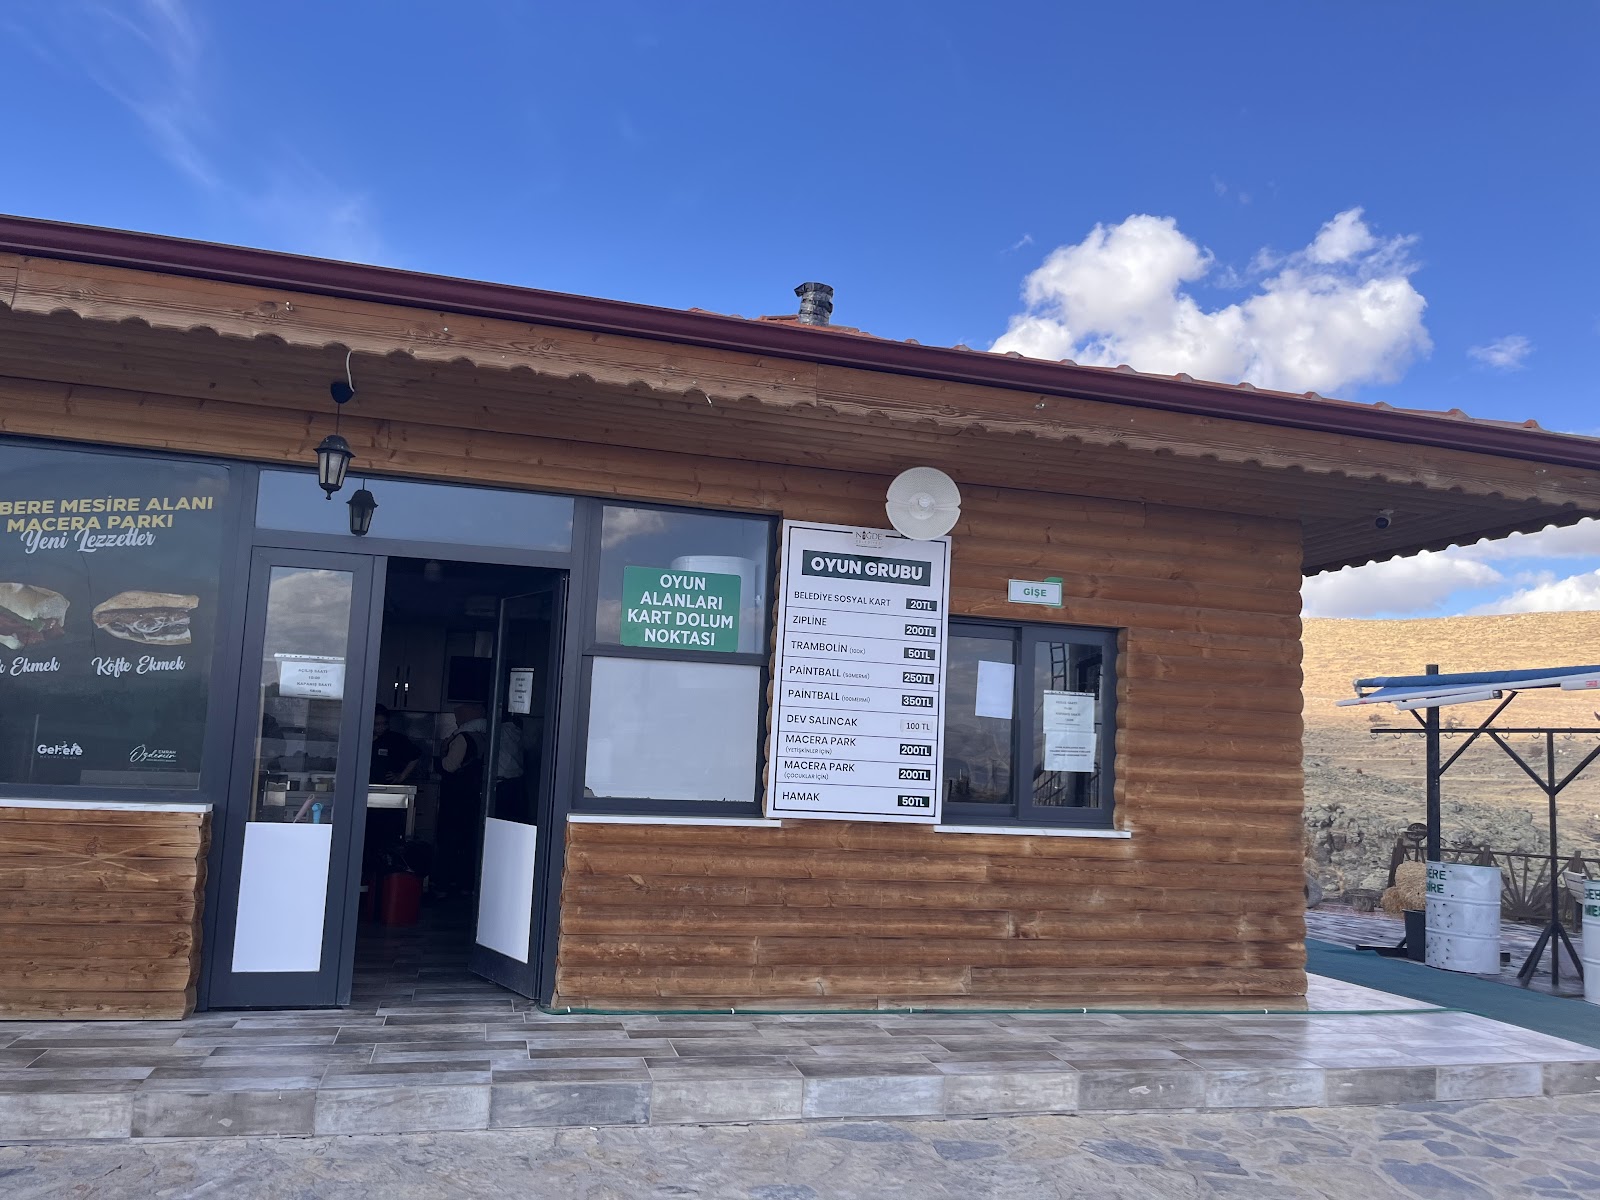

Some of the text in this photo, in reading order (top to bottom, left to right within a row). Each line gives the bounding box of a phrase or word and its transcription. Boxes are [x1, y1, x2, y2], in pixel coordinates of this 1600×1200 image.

[60, 495, 140, 513] MESİRE
[145, 496, 213, 511] ALANI
[7, 514, 173, 533] MACERA PARKI
[20, 527, 156, 554] Yeni Lezzetler
[811, 556, 923, 581] OYUN GRUBU
[659, 573, 706, 591] OYUN
[640, 590, 723, 611] ALANLARI
[794, 590, 933, 610] BELEDİYE SOSYAL KART 20TL
[1023, 586, 1047, 599] GİŞE
[627, 608, 734, 629] KART DOLUM
[644, 627, 716, 646] NOKTASI
[906, 625, 934, 637] 200TL
[791, 640, 848, 653] TRAMBOLİN
[908, 649, 930, 659] 50TL
[10, 656, 60, 676] Ekmek
[91, 655, 186, 678] Köfte Ekmek
[789, 665, 841, 678] PAİNTBALL
[904, 673, 933, 684] 250TL
[788, 688, 840, 701] PAİNTBALL
[902, 696, 932, 707] 350TL
[786, 714, 930, 731] DEV SALINCAK 100 TL
[785, 734, 930, 756] MACERA PARK 200TL
[784, 760, 929, 781] MACERA PARK 200TL
[782, 791, 925, 806] HAMAK 50TL
